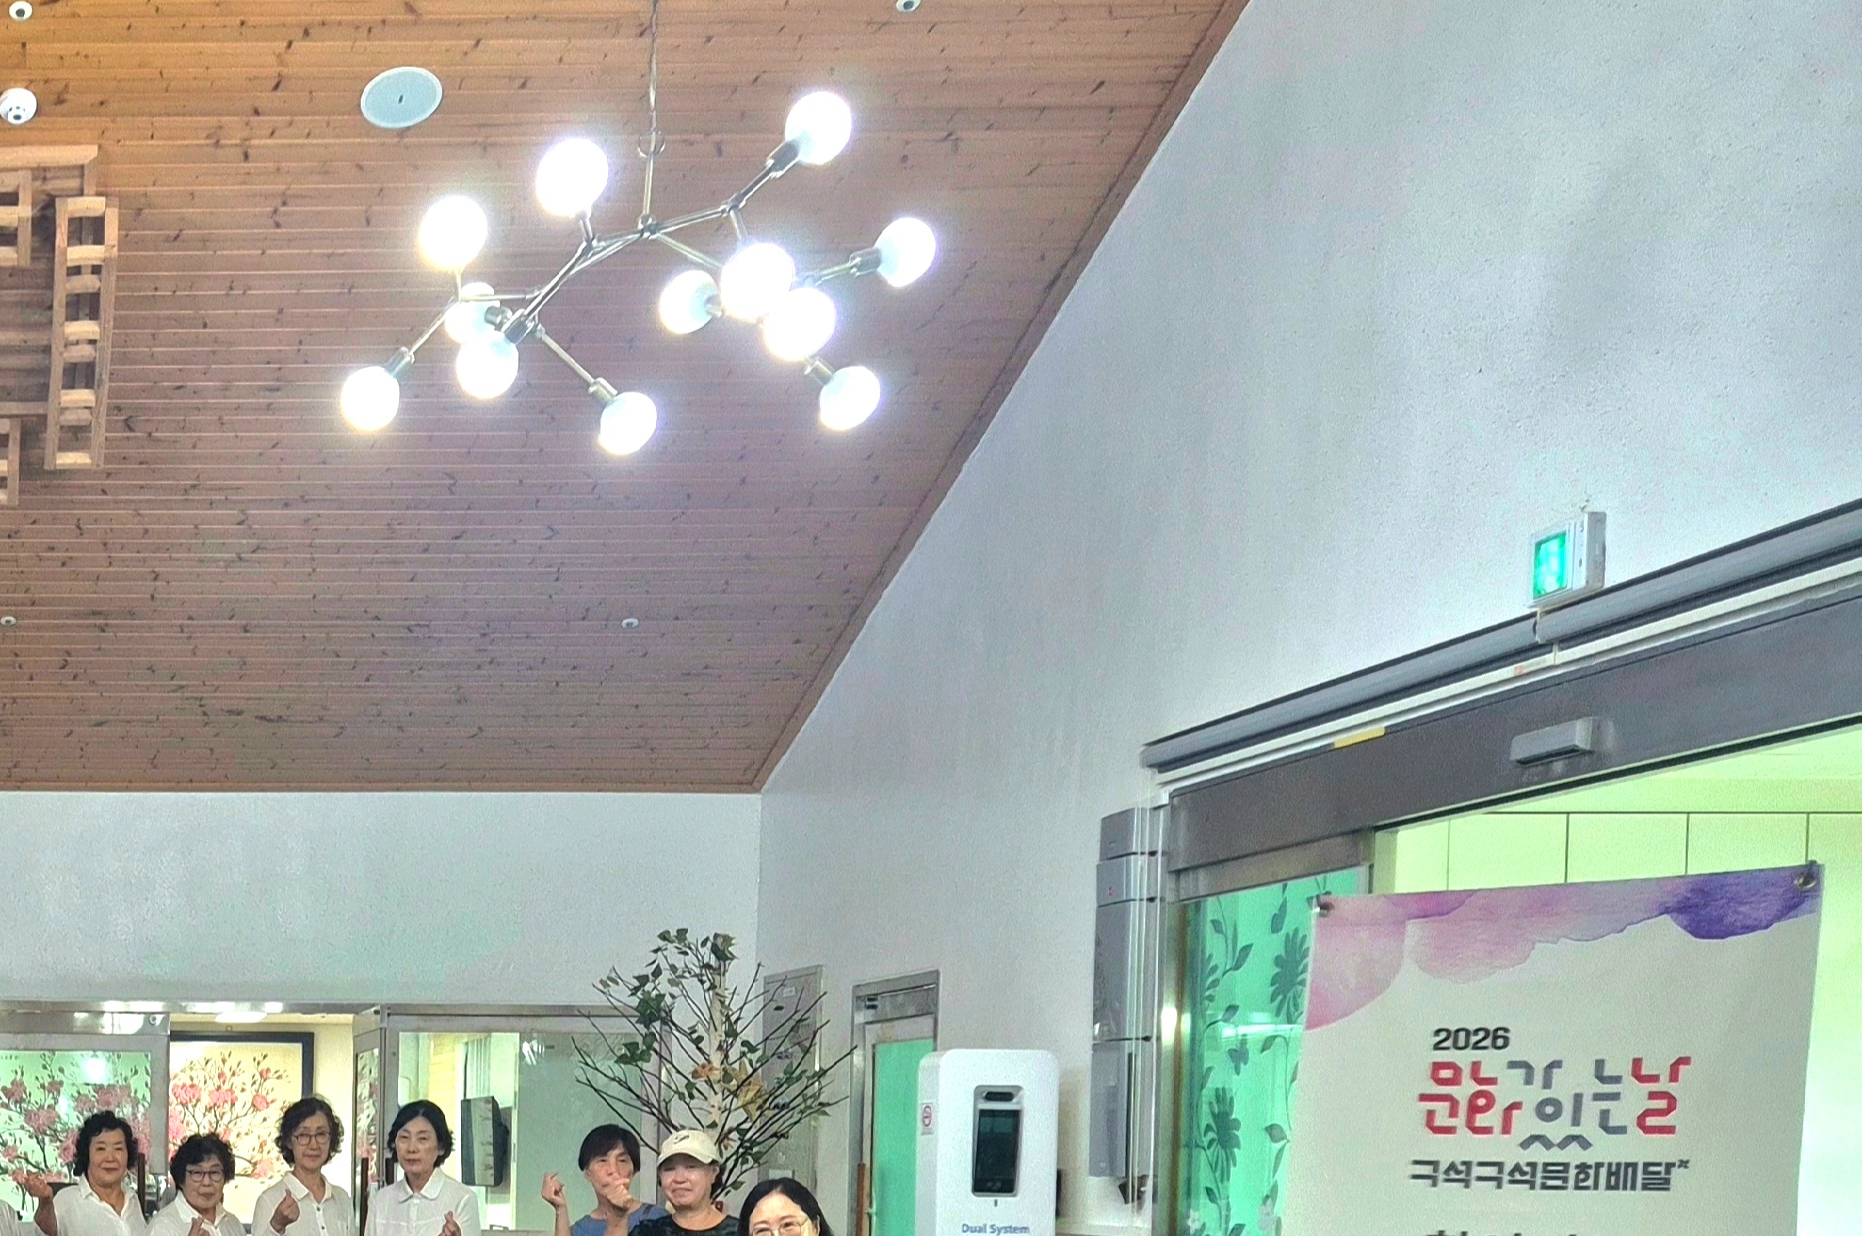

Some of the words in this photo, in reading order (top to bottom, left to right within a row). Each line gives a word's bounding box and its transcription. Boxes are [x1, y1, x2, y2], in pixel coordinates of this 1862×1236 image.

[1433, 1027, 1510, 1051] 2026
[962, 1224, 986, 1233] Dual
[990, 1224, 1029, 1236] System
